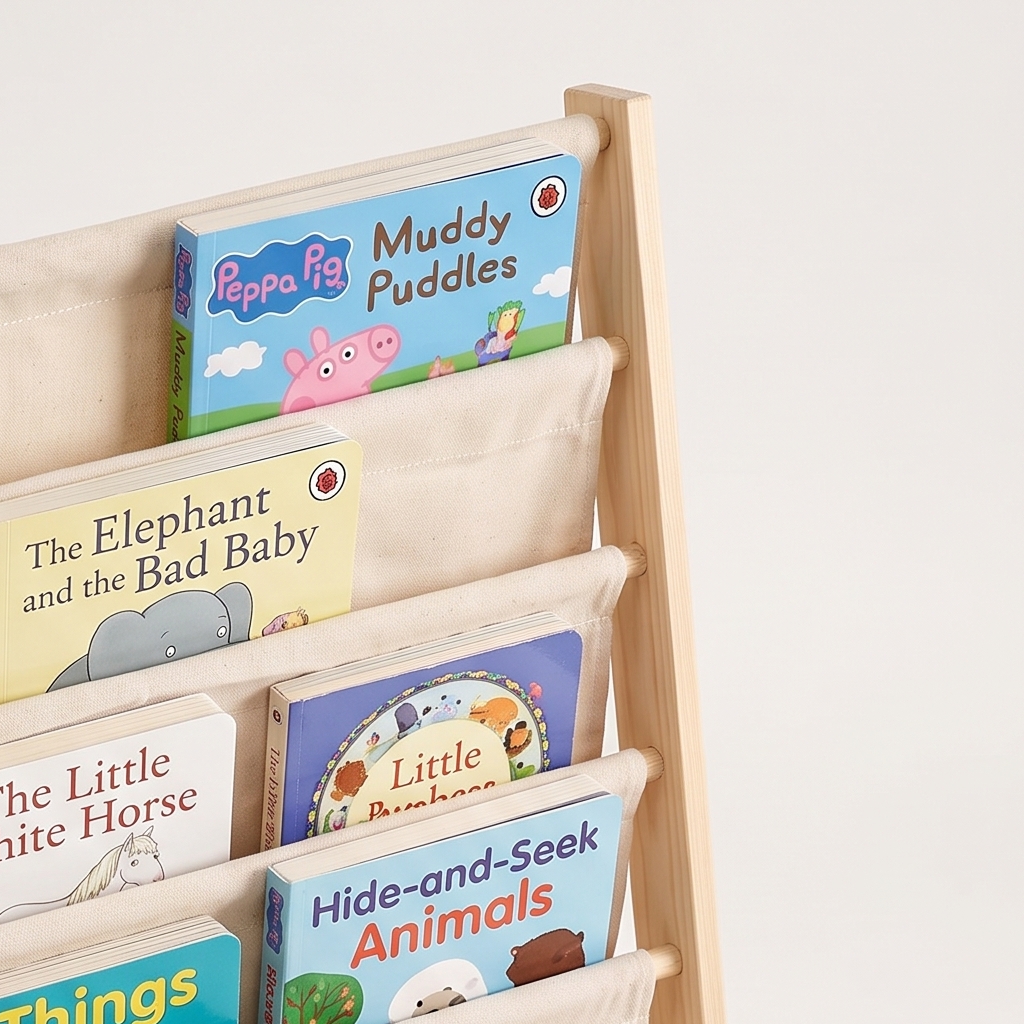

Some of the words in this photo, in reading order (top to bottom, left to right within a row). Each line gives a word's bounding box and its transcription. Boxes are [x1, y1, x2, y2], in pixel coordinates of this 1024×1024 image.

[373, 200, 512, 262] Muddy
[217, 261, 297, 312] Peppa
[304, 243, 346, 290] Pig
[367, 253, 518, 313] Puddles
[25, 539, 83, 570] The
[91, 486, 271, 556] Elephant
[23, 577, 74, 613] and
[83, 567, 126, 597] the
[135, 539, 209, 594] Bad
[222, 520, 320, 572] Baby
[66, 746, 171, 802] Little
[390, 740, 482, 791] Little
[80, 787, 198, 841] Horse
[312, 820, 599, 928] Hide-and-Seek
[349, 877, 554, 970] Animals
